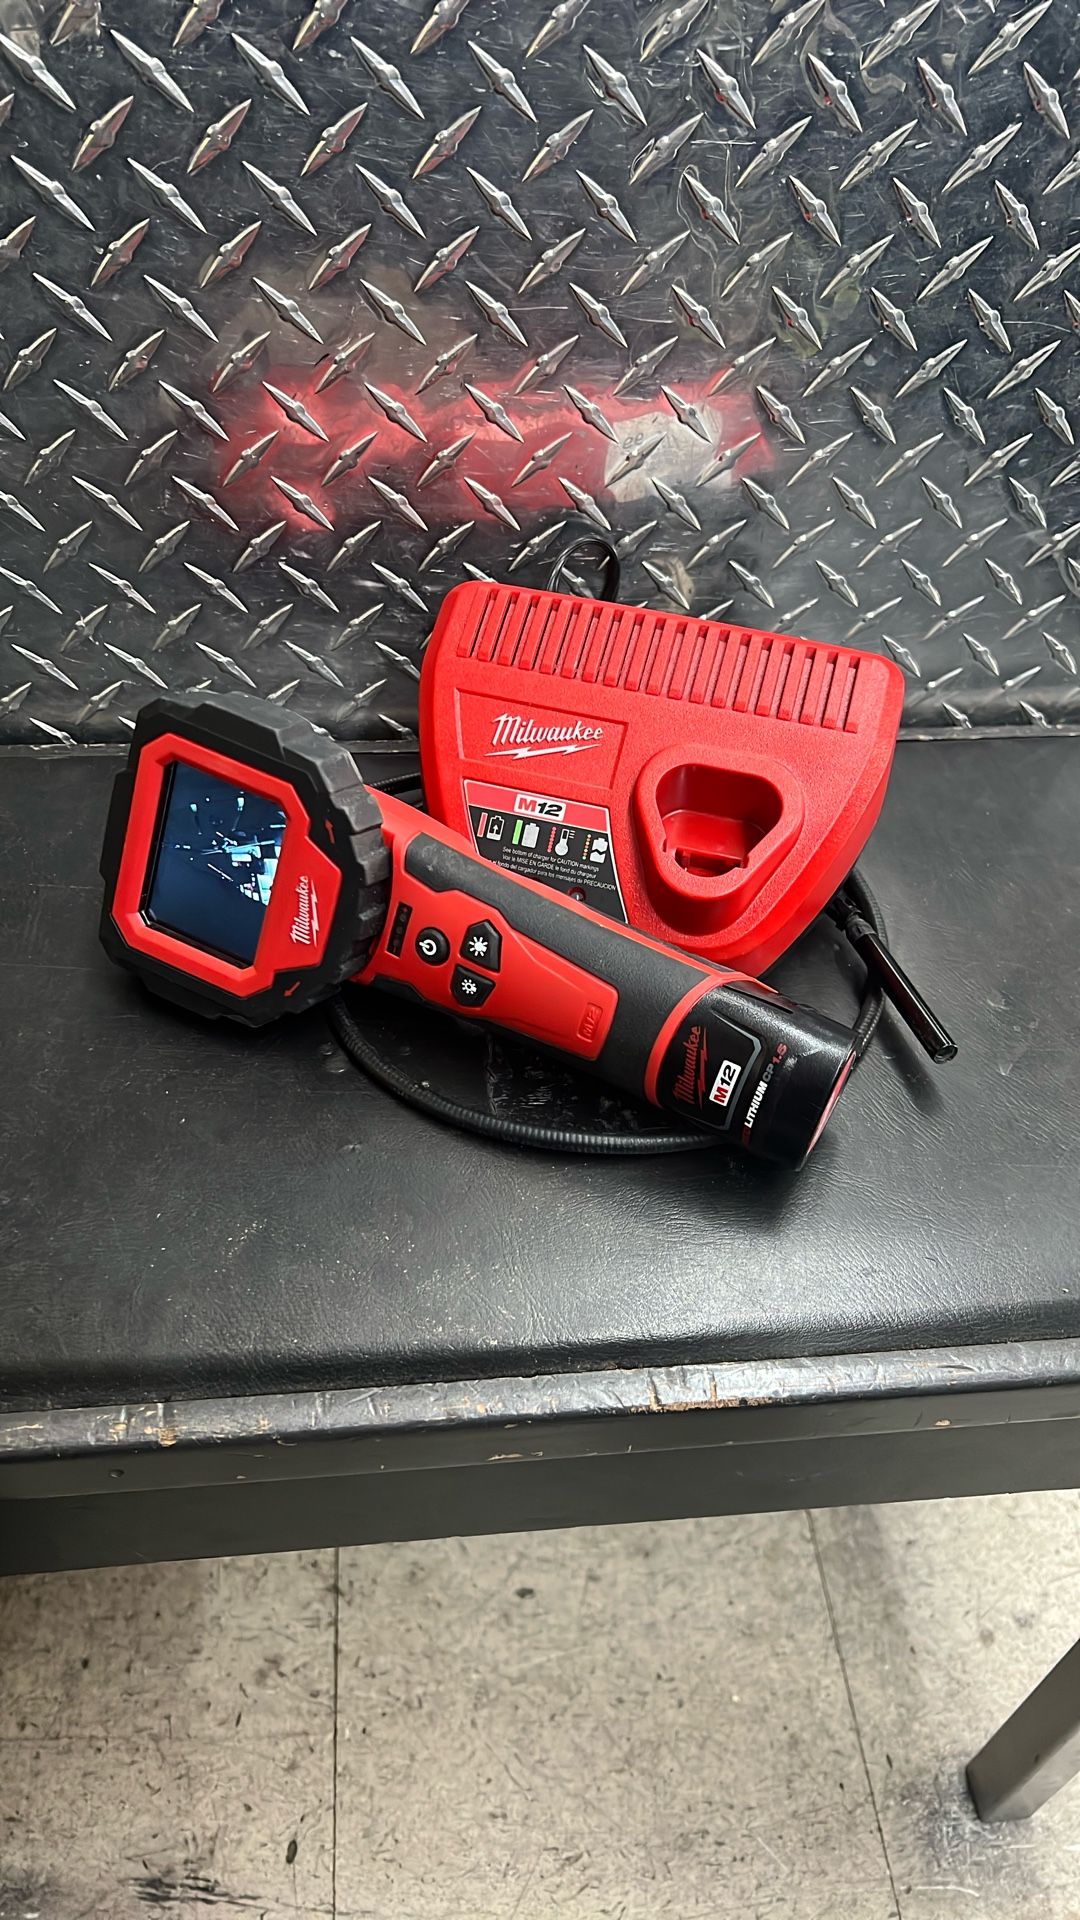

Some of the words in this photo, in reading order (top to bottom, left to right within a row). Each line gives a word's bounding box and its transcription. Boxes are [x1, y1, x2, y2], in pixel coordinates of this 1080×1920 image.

[491, 712, 604, 746] Milwaukee
[517, 798, 563, 816] M12
[517, 857, 528, 865] MISE
[537, 862, 554, 871] GARDE
[557, 857, 579, 867] CAUTION
[579, 863, 599, 872] markings
[289, 875, 311, 945] Milwaukee
[672, 1025, 702, 1105] Milwaukee
[713, 1064, 737, 1104] M12
